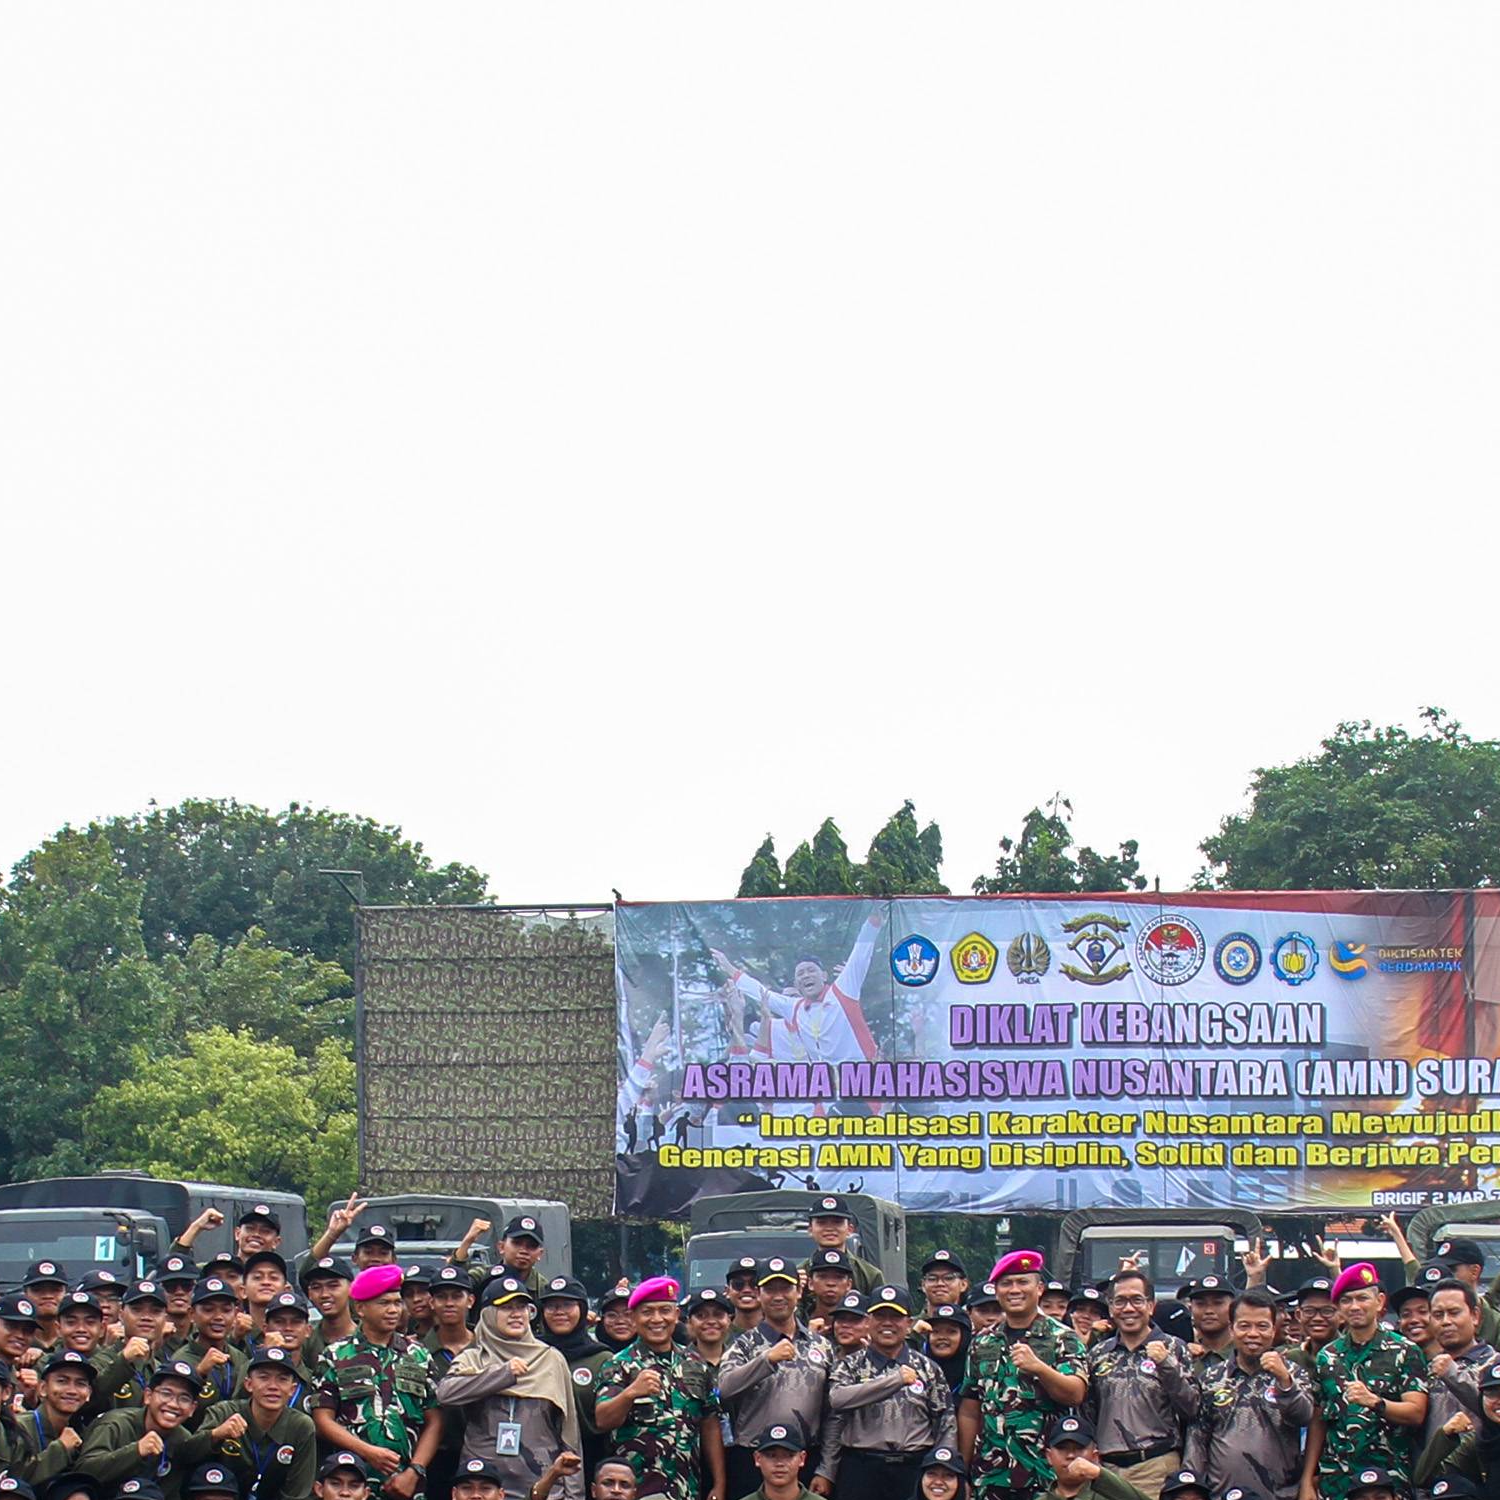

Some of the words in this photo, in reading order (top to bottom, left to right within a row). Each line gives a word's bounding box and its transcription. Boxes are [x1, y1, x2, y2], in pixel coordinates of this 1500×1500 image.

[950, 1003, 1075, 1046] DIKLAT
[1080, 1001, 1324, 1045] KEBANGSAAN
[682, 1062, 835, 1100] ASRAMA
[839, 1060, 1066, 1099] MAHASISWA
[1072, 1058, 1288, 1099] NUSANTARA
[1296, 1058, 1408, 1097] (AMN)
[759, 1112, 981, 1138] Internalisasi
[986, 1110, 1137, 1137] Karakter
[1143, 1111, 1324, 1136] Nusantara
[657, 1144, 811, 1169] Generasi
[815, 1144, 892, 1168] AMN
[898, 1144, 982, 1171] Yang
[987, 1142, 1129, 1170] Disiplin,
[1134, 1141, 1224, 1168] Solid
[1231, 1141, 1298, 1166] dan
[1305, 1140, 1441, 1169] Berjiwa
[1373, 1191, 1427, 1206] BRIGIF
[1431, 1191, 1444, 1205] 2
